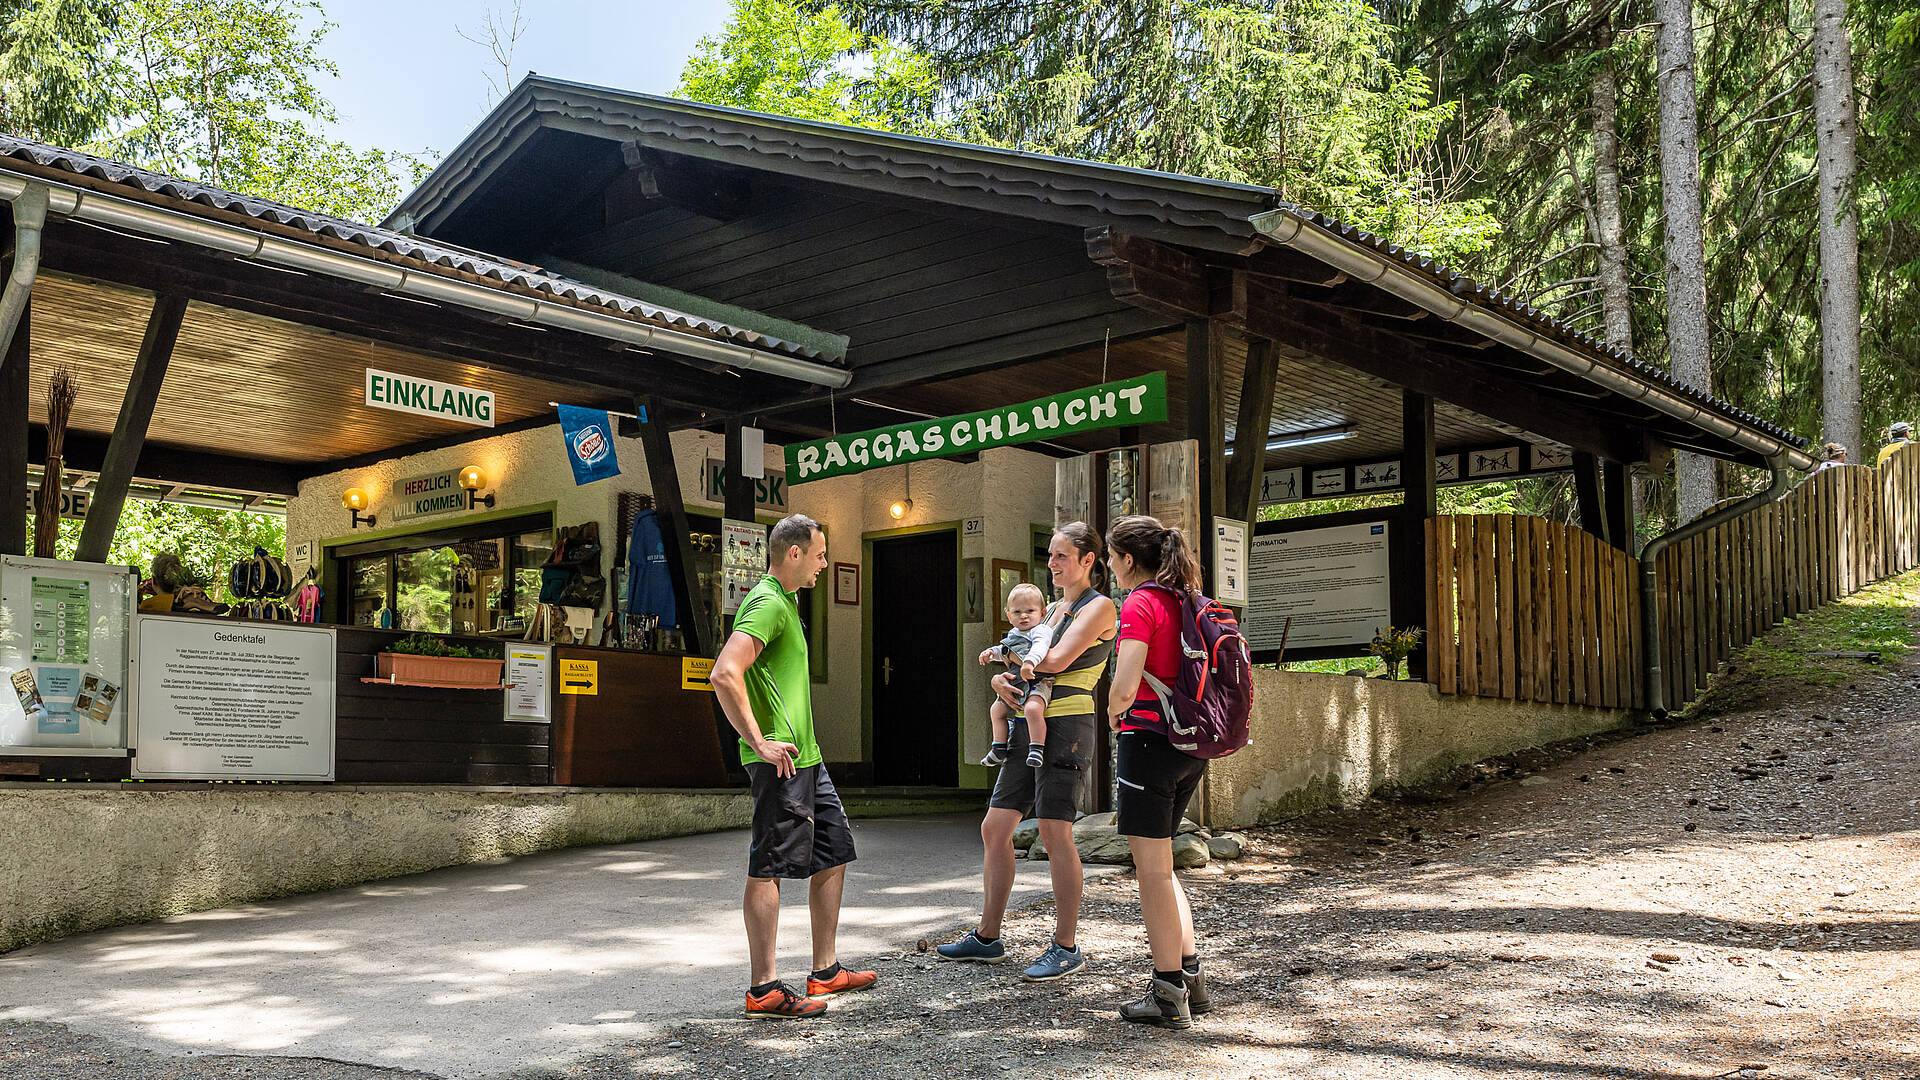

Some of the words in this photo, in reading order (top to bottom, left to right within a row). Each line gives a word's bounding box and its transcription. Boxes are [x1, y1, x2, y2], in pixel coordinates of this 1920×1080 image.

[371, 375, 490, 420] EINKLANG
[798, 385, 1146, 478] RAGGASCHLUCHT
[405, 474, 450, 496] HERZLICH
[713, 466, 784, 506] KSK
[394, 493, 463, 518] WILLKOMMEN
[967, 520, 979, 530] 37
[296, 544, 308, 556] WC
[1251, 538, 1288, 548] FORMATION
[214, 632, 266, 644] Gedenktafel
